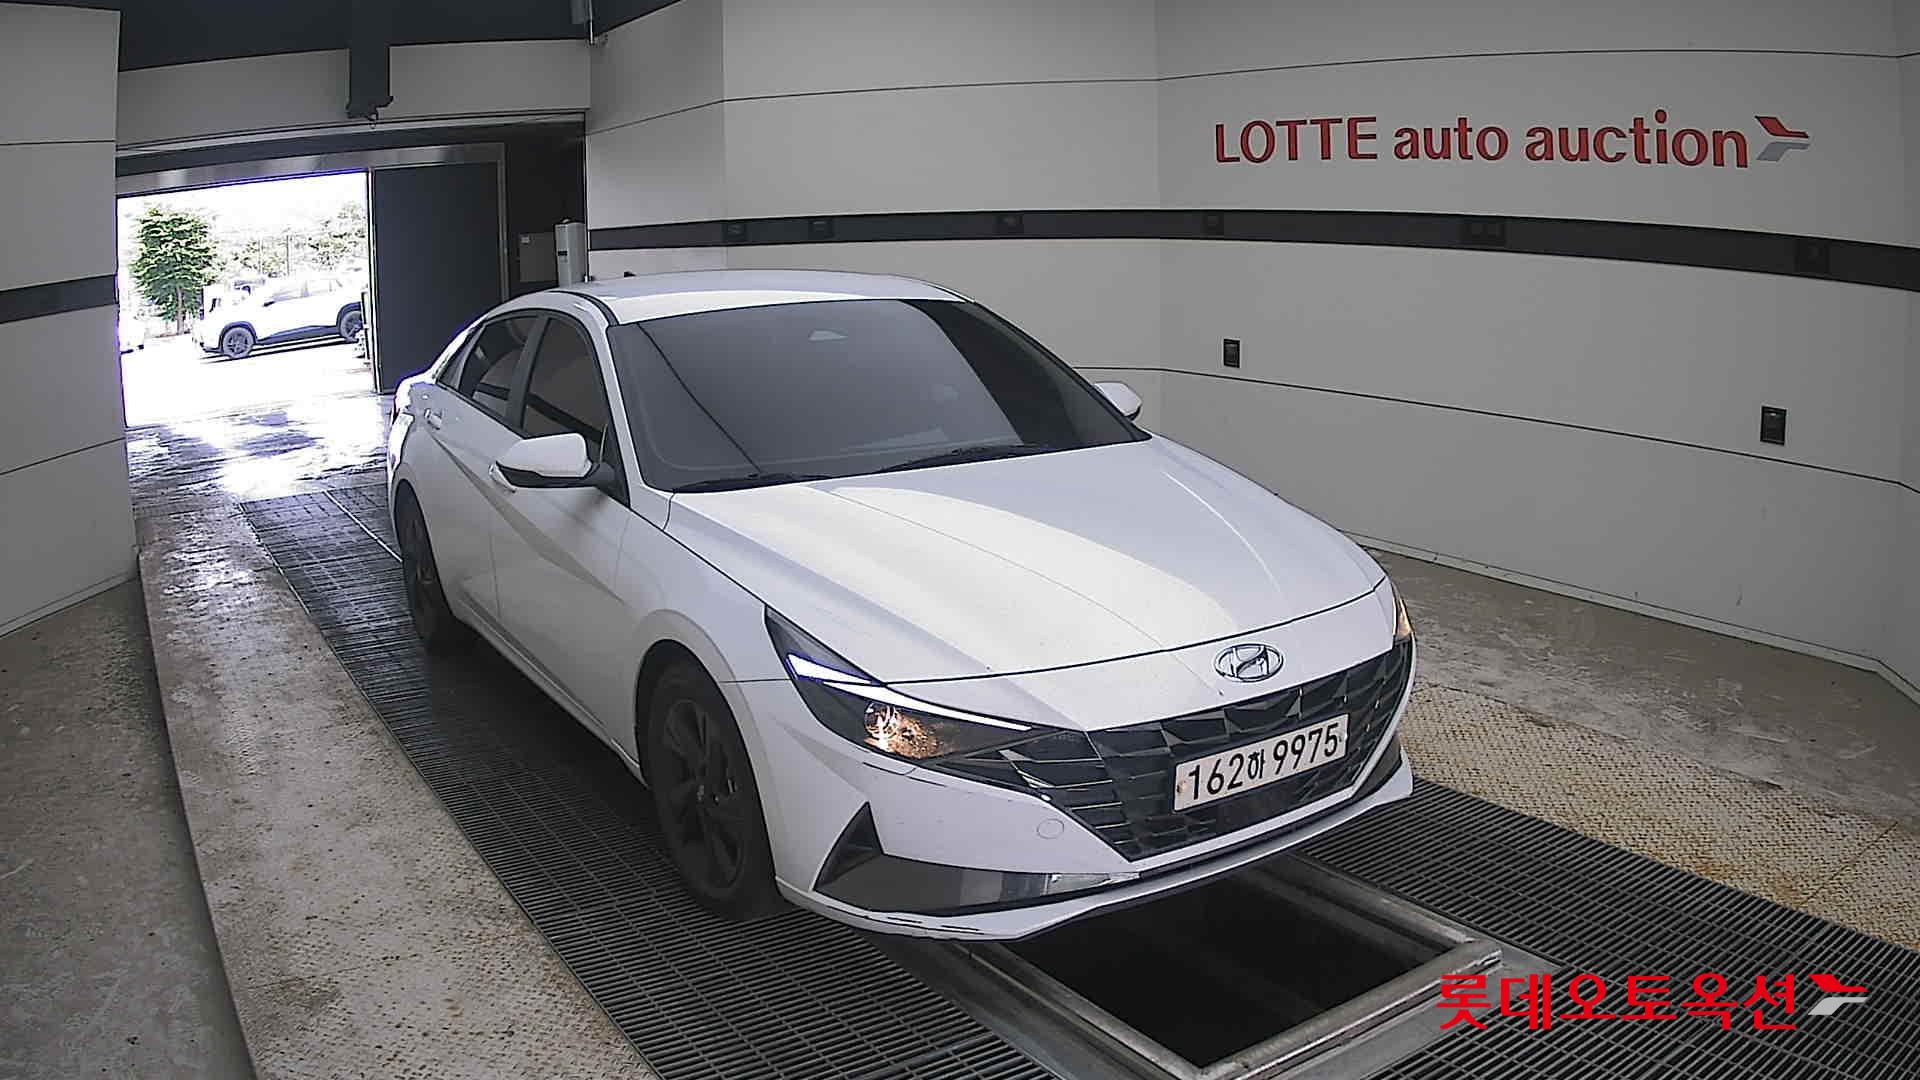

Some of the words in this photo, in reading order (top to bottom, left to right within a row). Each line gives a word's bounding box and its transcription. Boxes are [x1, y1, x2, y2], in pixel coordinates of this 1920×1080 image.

[1215, 116, 1378, 163] LOTTE
[1393, 117, 1509, 161] auto
[1525, 109, 1748, 168] auction
[1188, 749, 1265, 801] 162하
[1273, 722, 1340, 775] 9975
